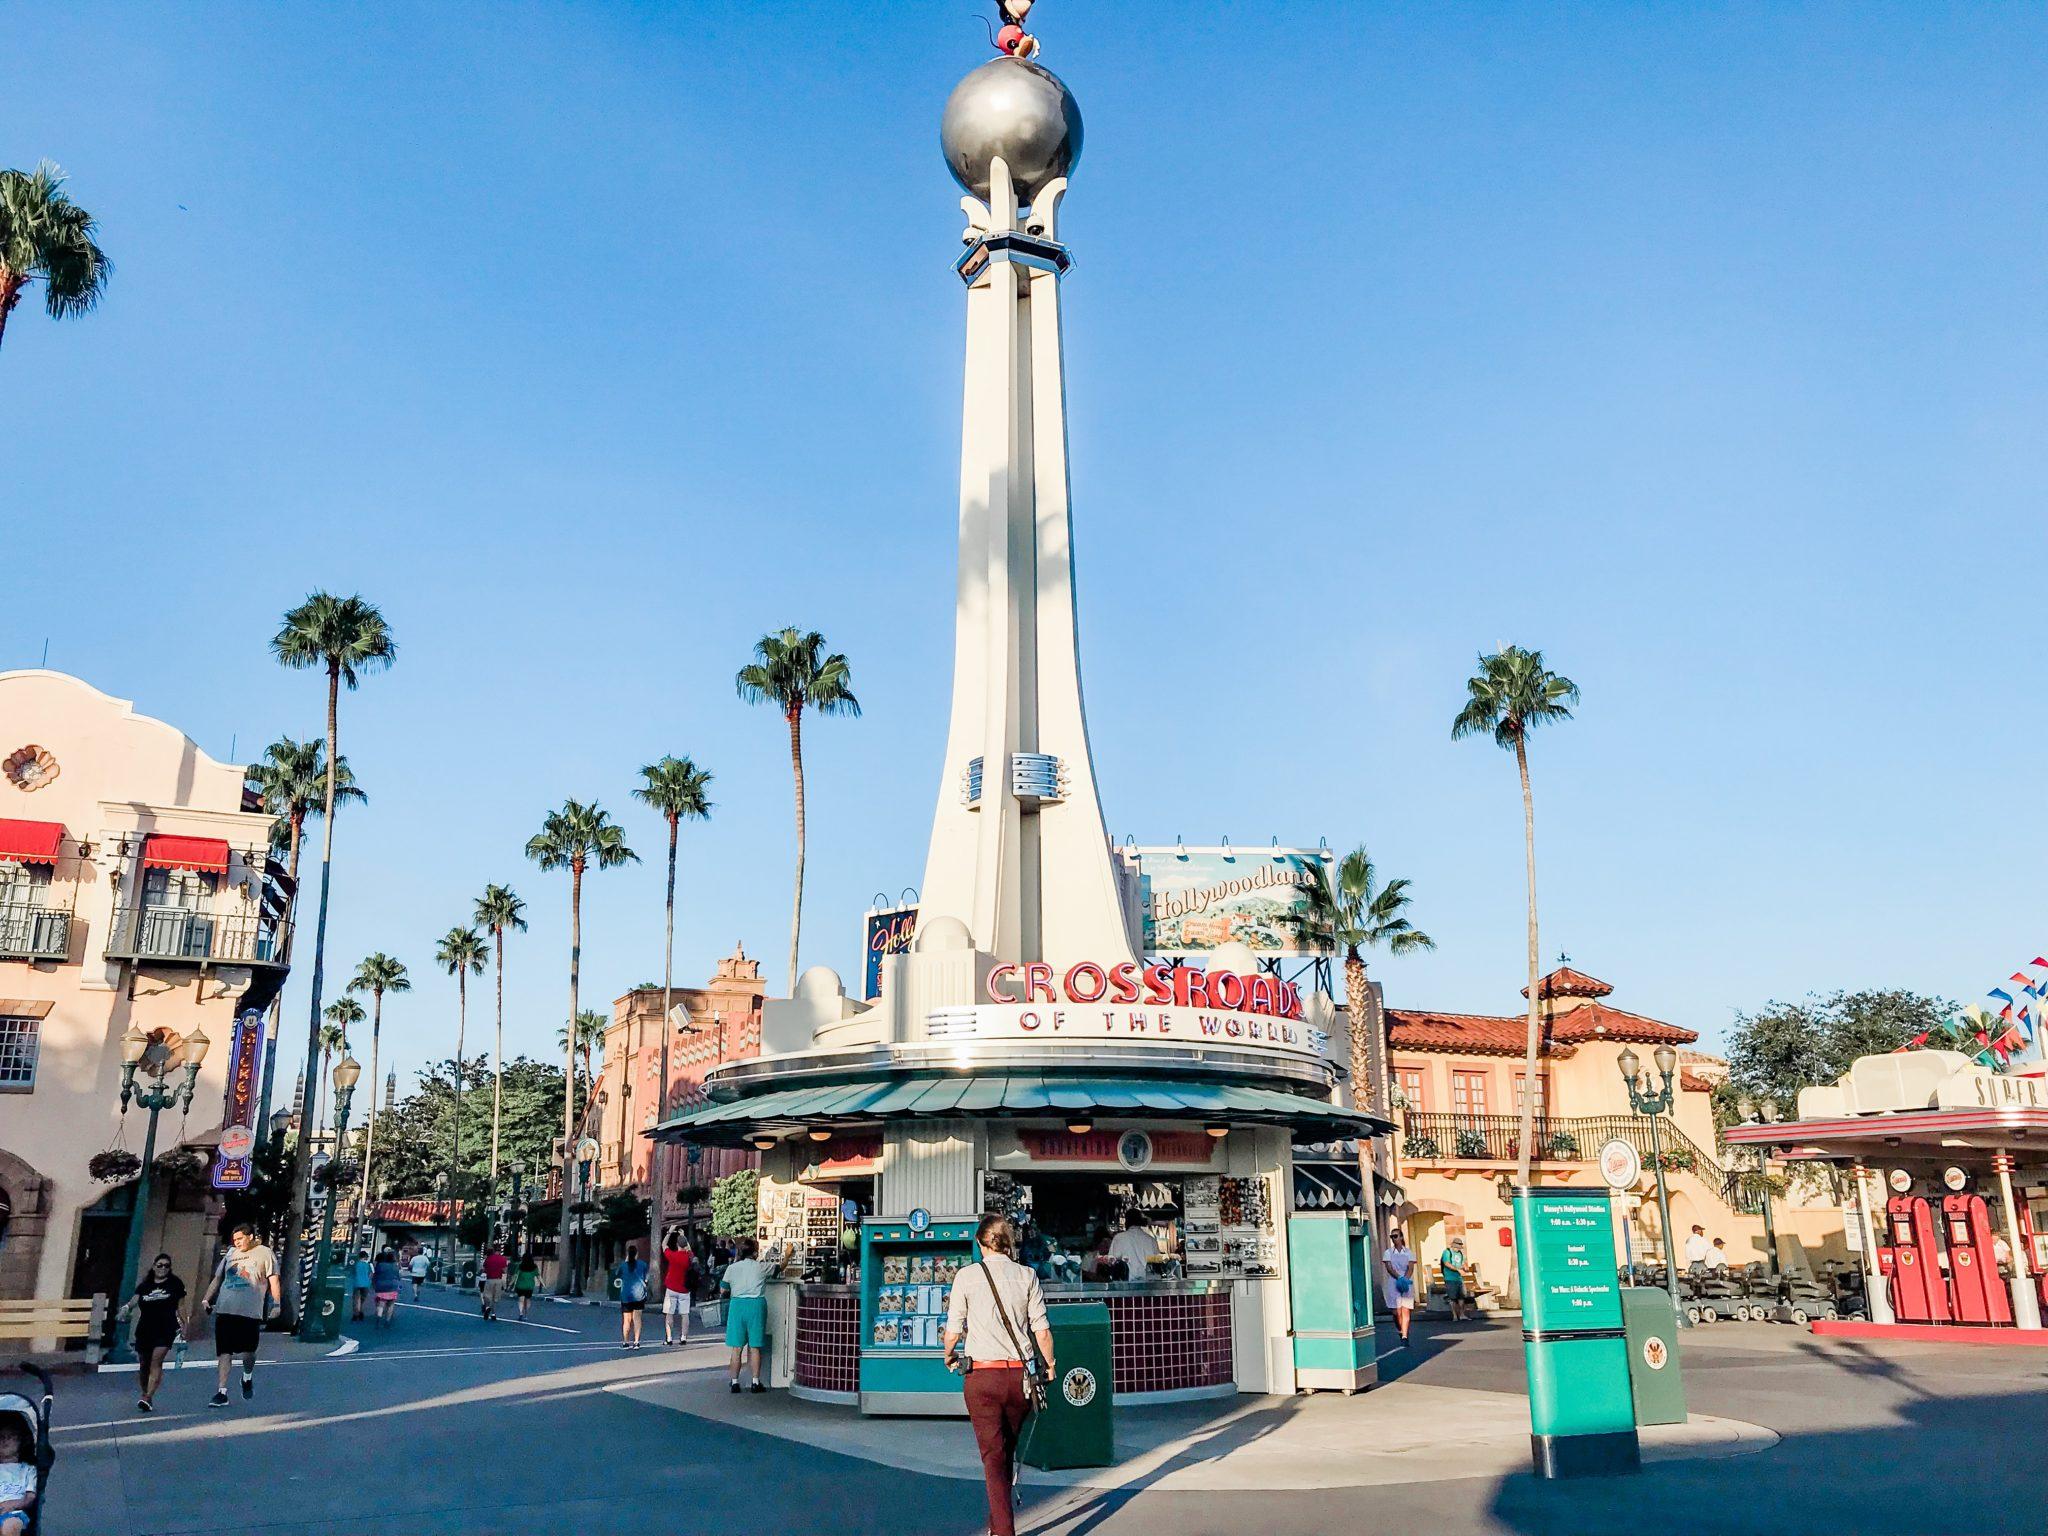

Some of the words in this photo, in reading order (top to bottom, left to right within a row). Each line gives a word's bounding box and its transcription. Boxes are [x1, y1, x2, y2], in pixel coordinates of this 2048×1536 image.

[1149, 864, 1318, 922] Hollywoodland
[986, 962, 1306, 1018] CROSSROADS
[1020, 1011, 1065, 1031] OF
[1103, 1012, 1171, 1033] THE
[1200, 1015, 1298, 1044] WORLD
[1544, 1205, 1563, 1214] Disney's
[1564, 1205, 1588, 1214] Hollywood
[1588, 1205, 1606, 1213] Studios
